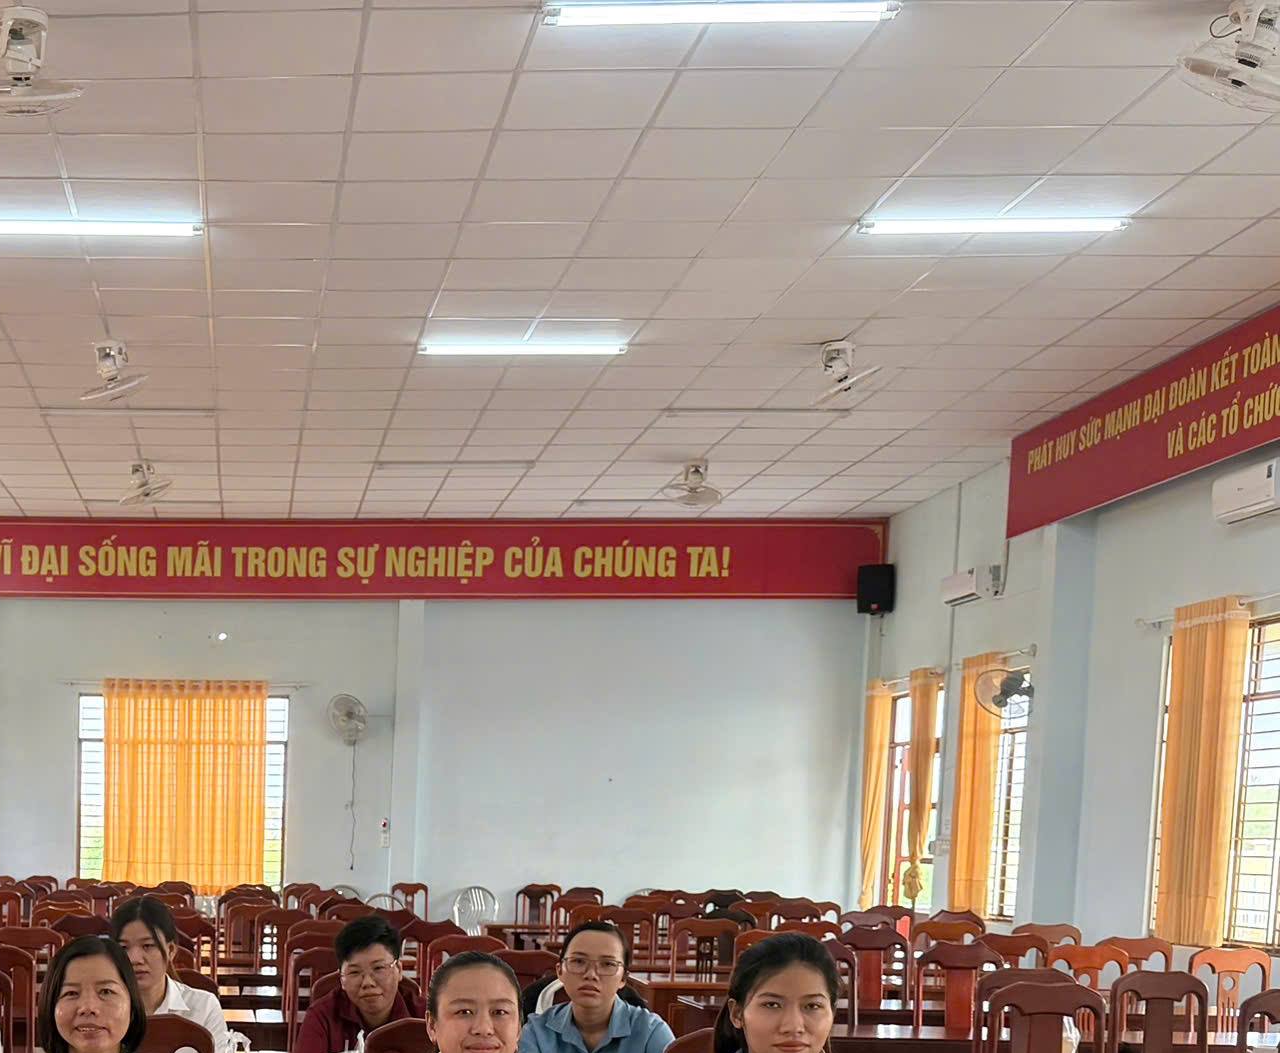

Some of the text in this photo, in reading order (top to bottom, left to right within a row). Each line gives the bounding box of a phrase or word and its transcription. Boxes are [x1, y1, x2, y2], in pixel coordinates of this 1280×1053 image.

[1027, 438, 1055, 475] PHÁT
[1055, 428, 1077, 463] HUY
[1078, 415, 1102, 451] SỨC
[1103, 399, 1142, 440] MẠNH
[1143, 386, 1166, 424] ĐẠI
[1168, 366, 1208, 411] ĐOÀN
[1210, 345, 1239, 393] KẾT
[1167, 421, 1184, 459] VÀ
[1187, 410, 1217, 451] CÁC
[1221, 390, 1241, 438] TỔ
[20, 544, 69, 582] ĐẠI
[78, 534, 157, 577] SỐNG
[167, 540, 221, 578] MÃI
[231, 546, 327, 578] TRONG
[336, 543, 379, 584] SỰ
[384, 540, 494, 584] NGHIỆP
[503, 536, 564, 578] CỦA
[573, 539, 677, 578] CHÚNG
[686, 546, 731, 578] TA!
